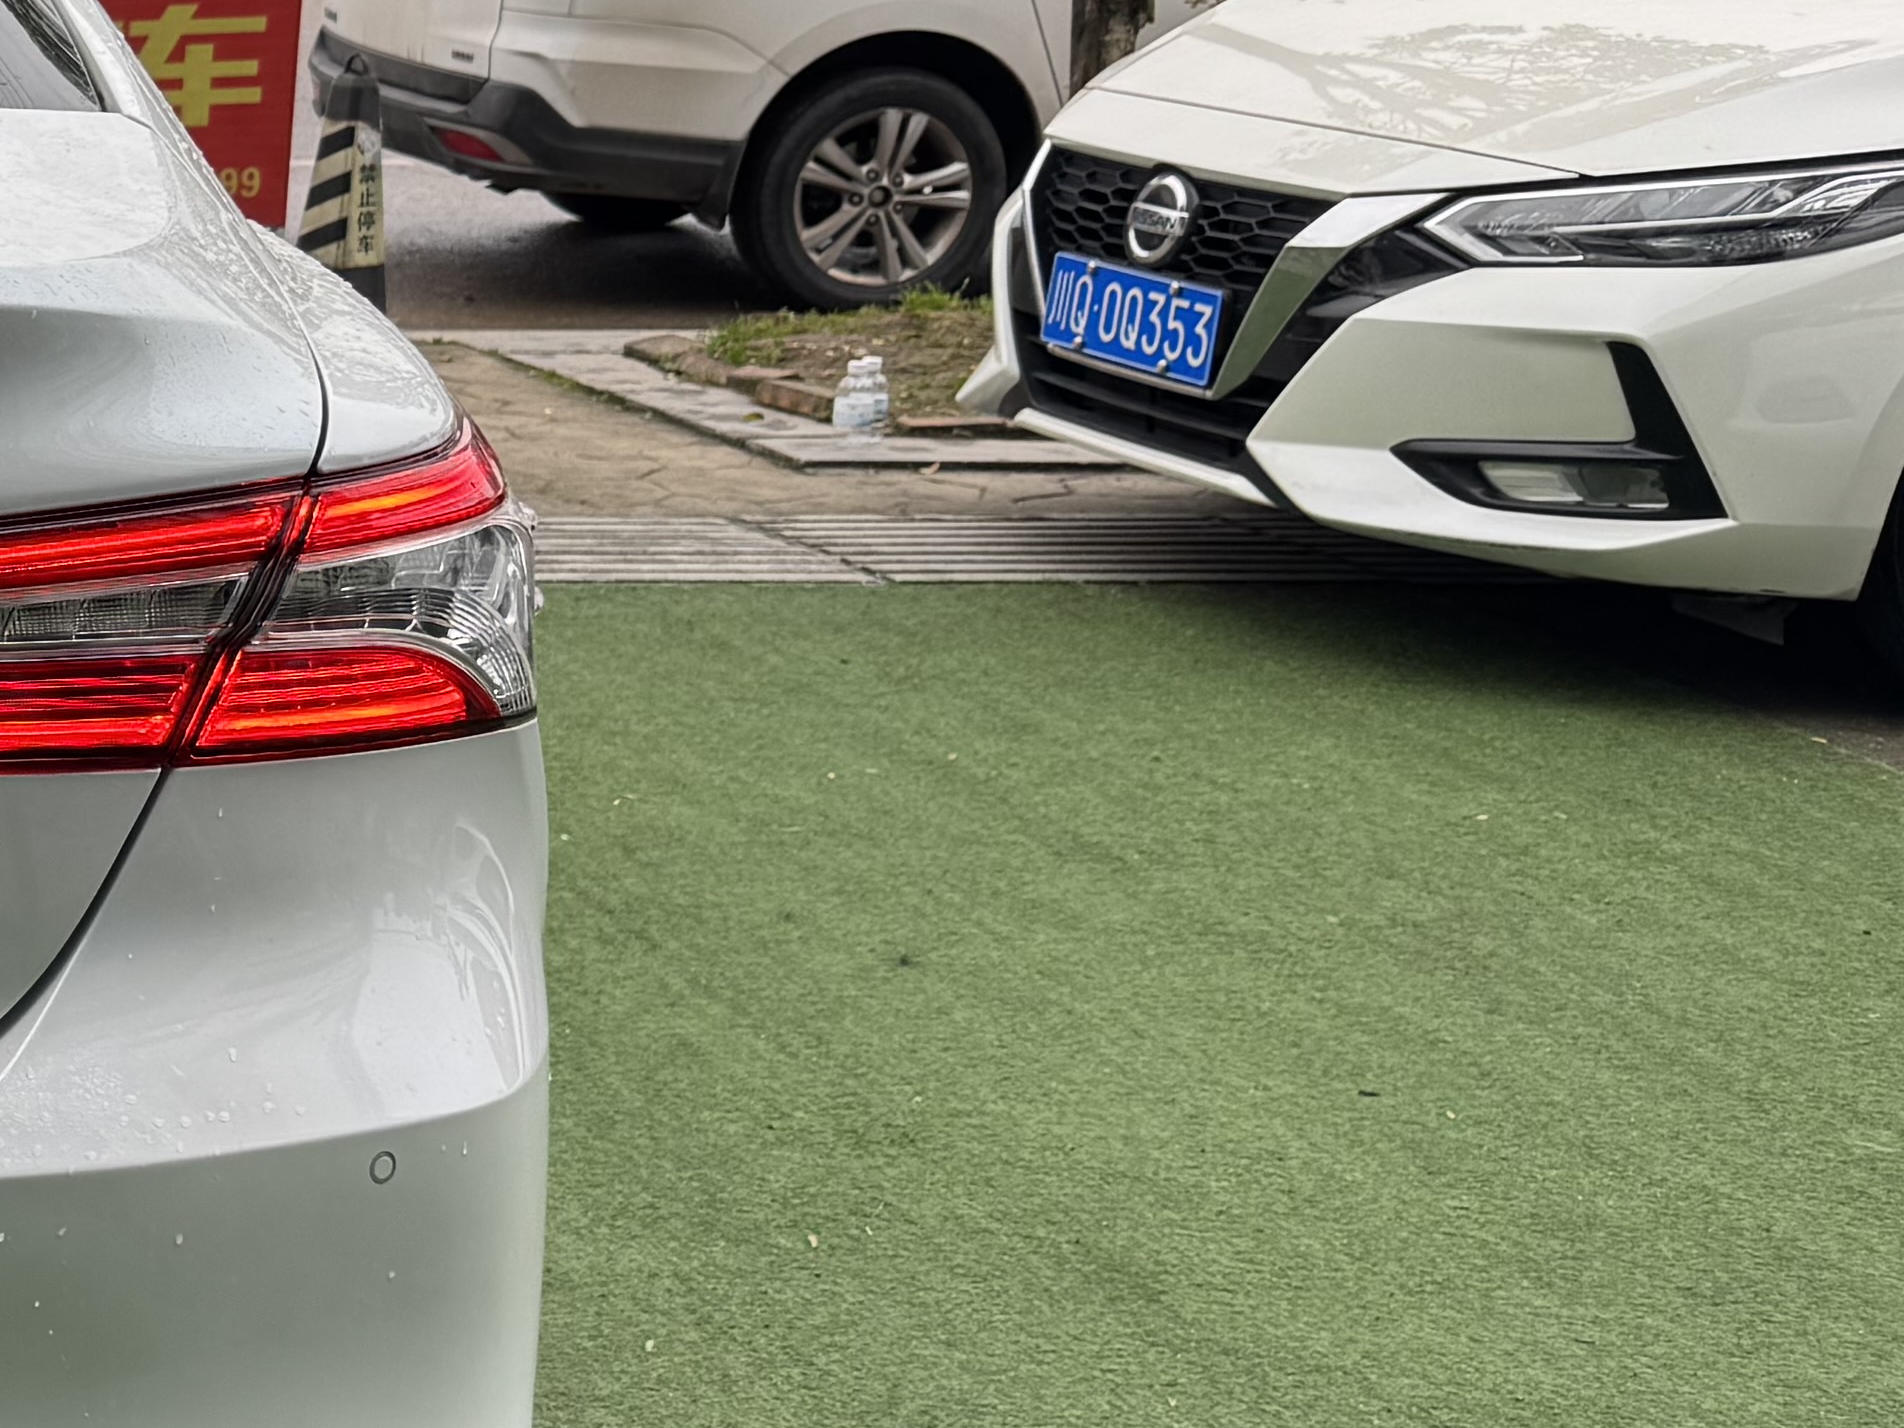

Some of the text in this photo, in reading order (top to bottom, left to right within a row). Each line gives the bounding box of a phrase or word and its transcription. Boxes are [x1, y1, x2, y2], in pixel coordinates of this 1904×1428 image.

[117, 4, 267, 128] 车
[357, 163, 376, 255] 禁止停车
